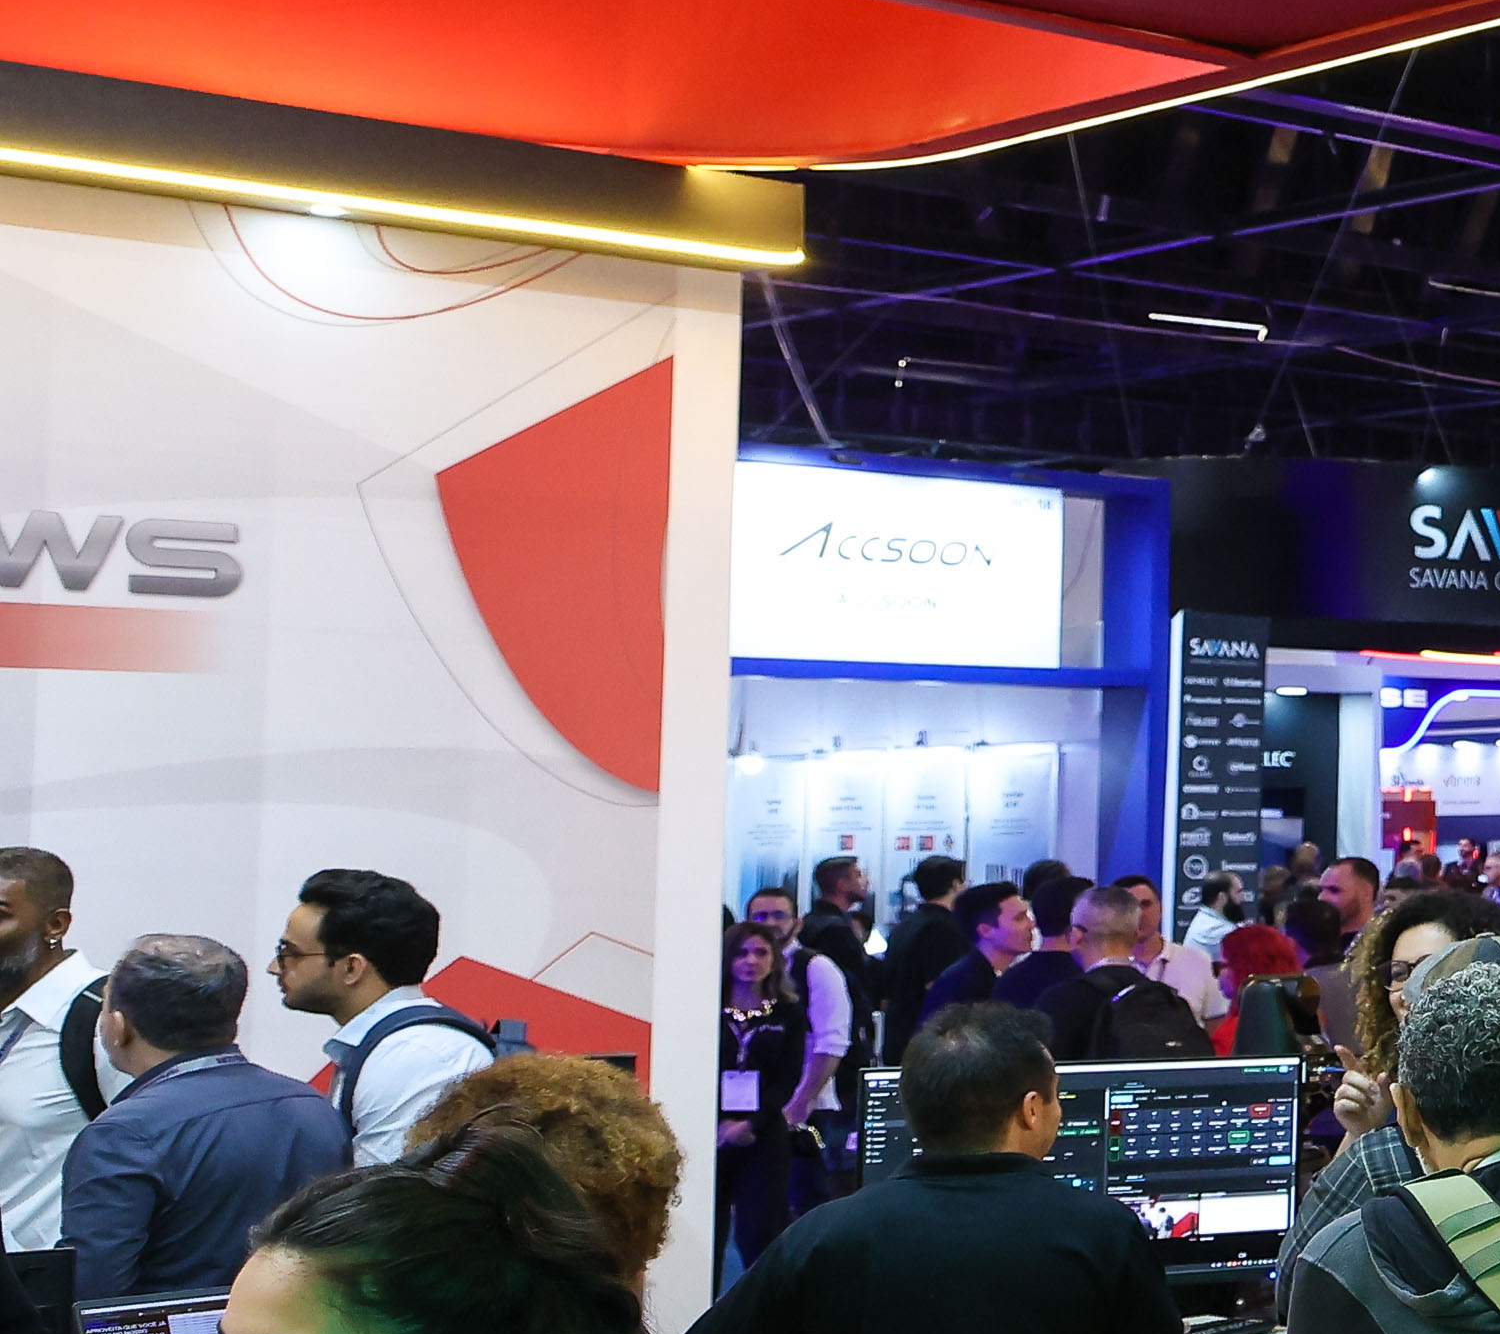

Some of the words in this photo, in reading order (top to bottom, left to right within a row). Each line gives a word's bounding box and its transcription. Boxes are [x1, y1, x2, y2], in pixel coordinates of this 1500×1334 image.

[779, 521, 993, 567] ACCSOON
[1409, 567, 1489, 591] SAVANA
[1189, 637, 1260, 660] SAVANA
